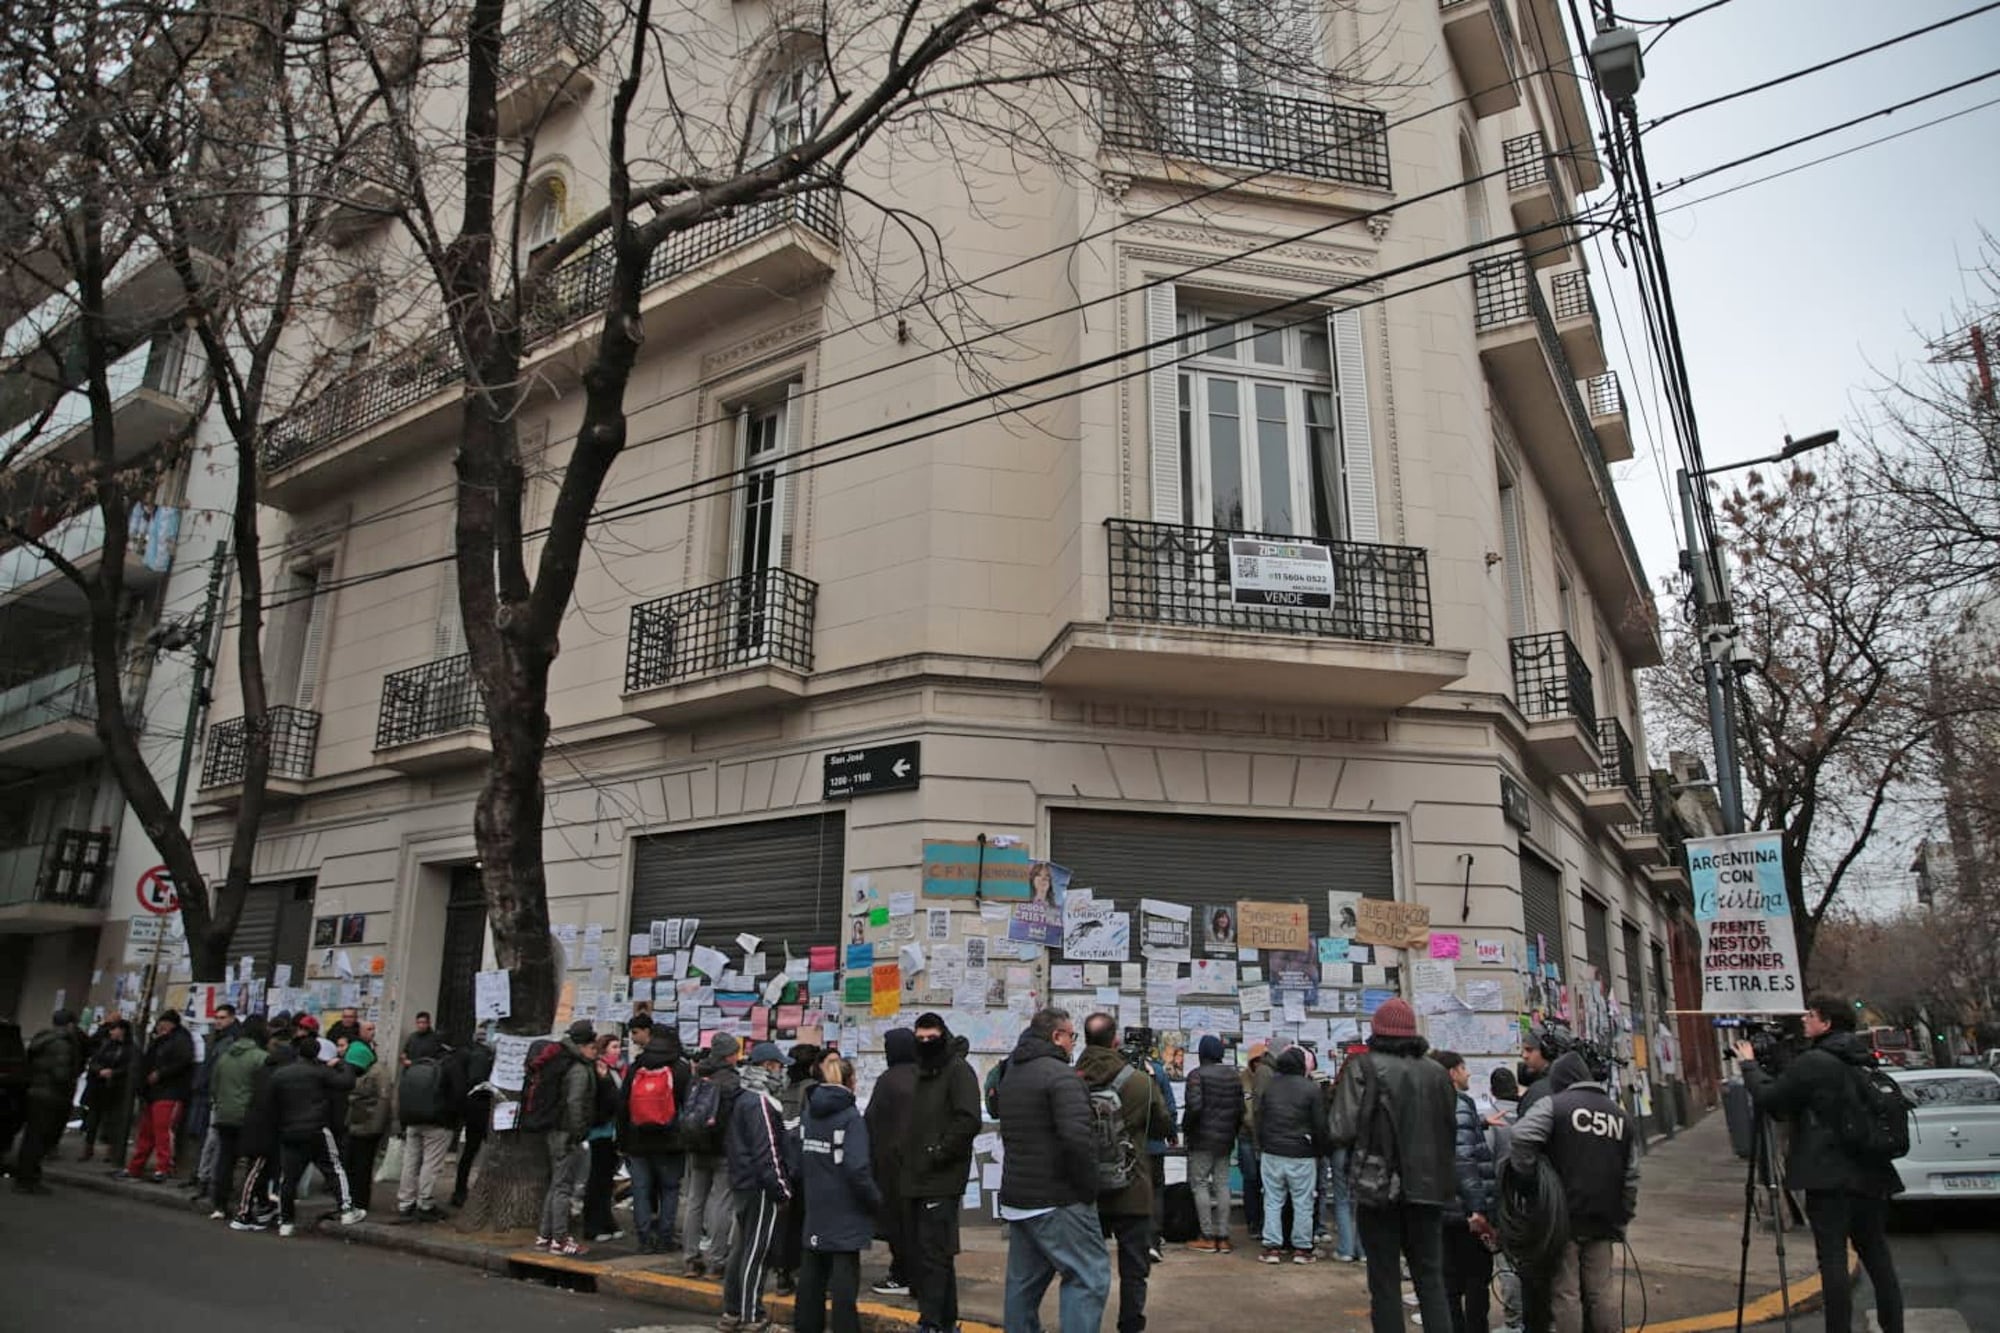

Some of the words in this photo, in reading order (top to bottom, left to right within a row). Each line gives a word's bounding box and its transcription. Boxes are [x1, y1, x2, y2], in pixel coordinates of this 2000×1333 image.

[1264, 591, 1304, 605] VENDE
[830, 756, 845, 765] San
[1692, 849, 1778, 871] ARGENTINA
[1720, 869, 1754, 884] CON
[1251, 926, 1297, 945] PUEBLO
[1711, 920, 1766, 935] FRENTE
[1709, 935, 1773, 952] NESTOR
[1704, 953, 1785, 970] KIRCHNER
[1705, 975, 1796, 993] FE.TRA.E.S
[1571, 1108, 1623, 1140] C5N
